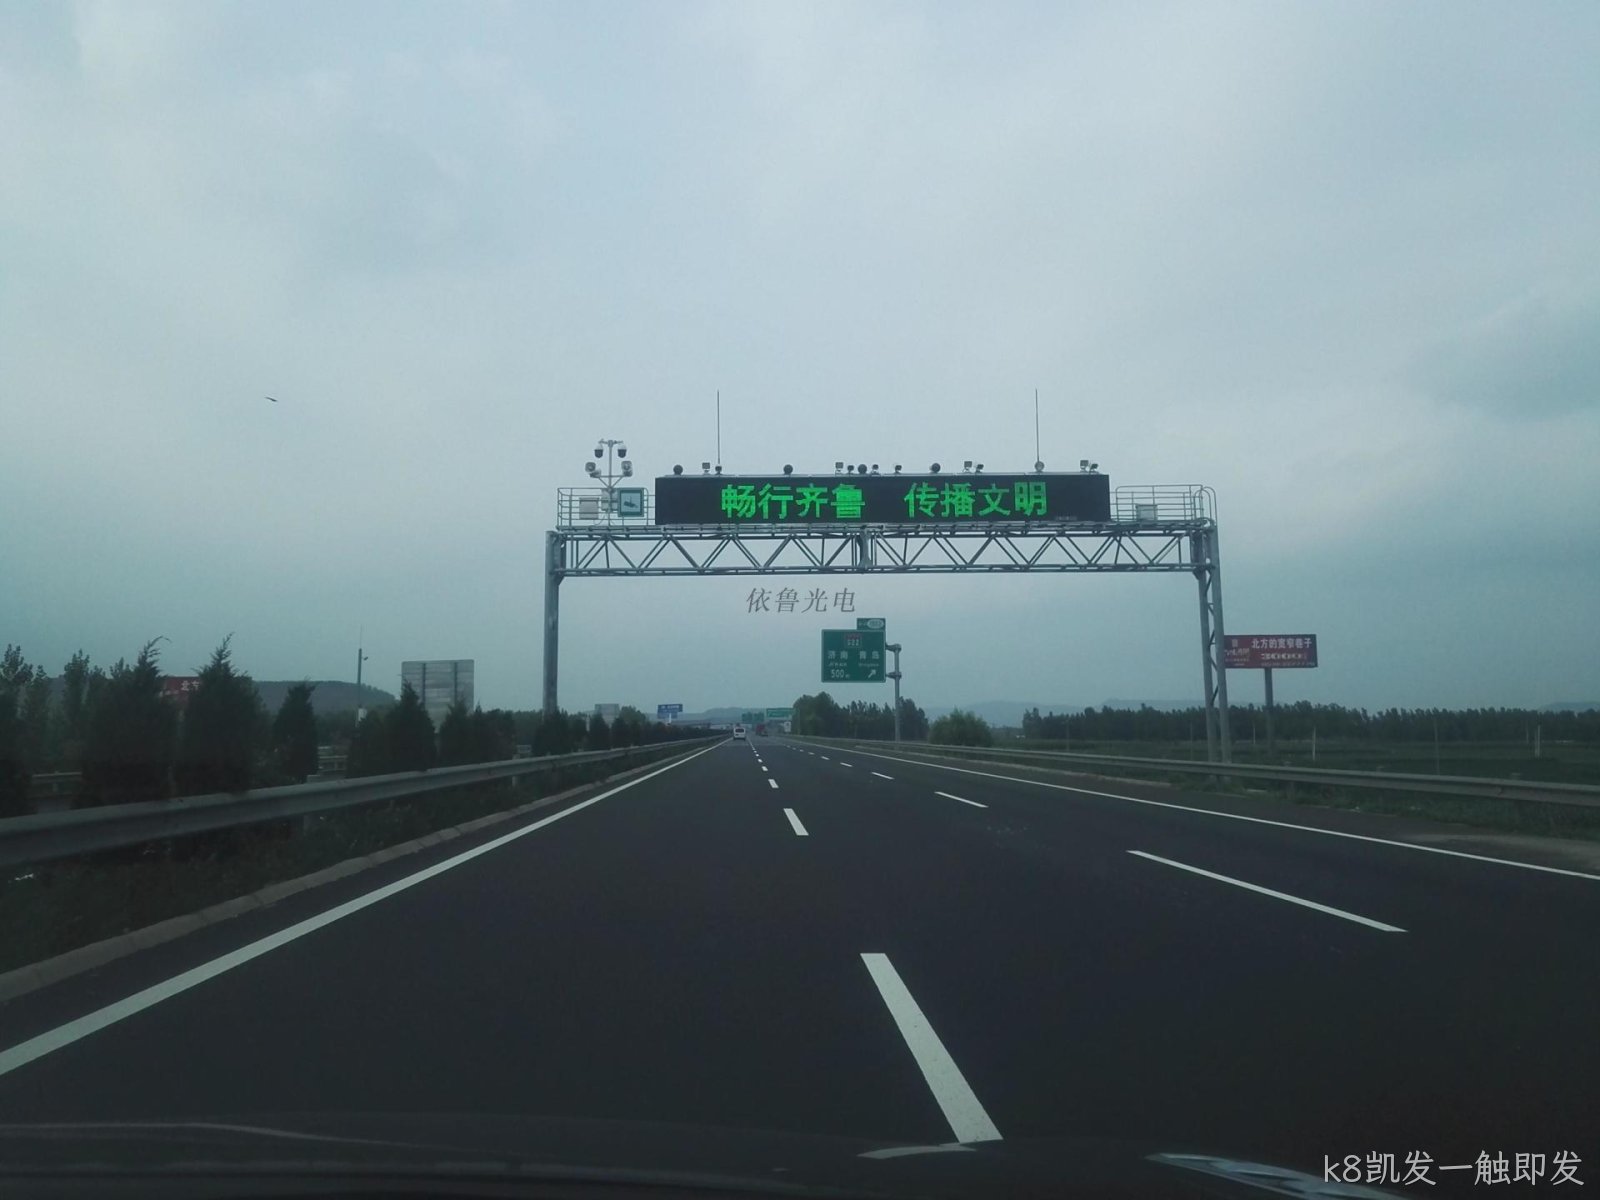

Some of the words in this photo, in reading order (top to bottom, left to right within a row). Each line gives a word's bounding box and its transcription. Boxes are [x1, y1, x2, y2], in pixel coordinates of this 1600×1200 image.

[721, 483, 866, 519] 畅行齐鲁
[904, 481, 1048, 518] 传播文明
